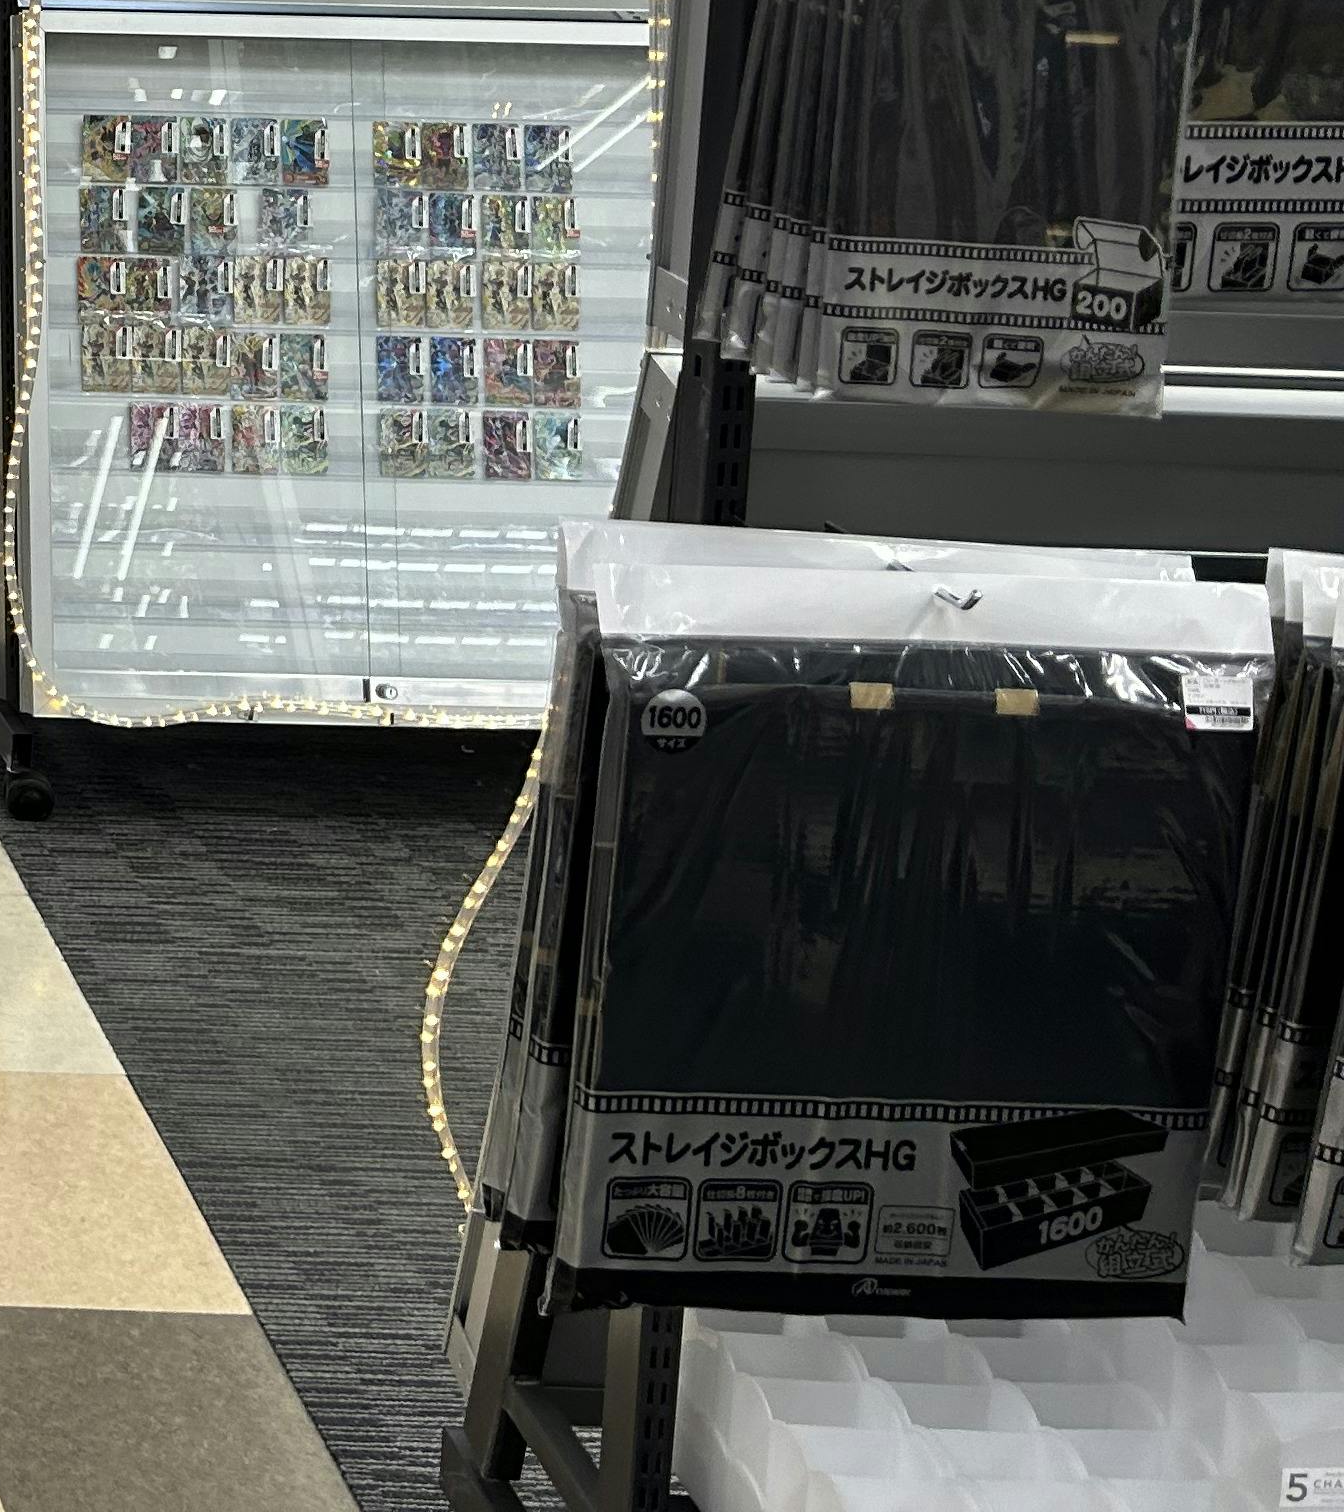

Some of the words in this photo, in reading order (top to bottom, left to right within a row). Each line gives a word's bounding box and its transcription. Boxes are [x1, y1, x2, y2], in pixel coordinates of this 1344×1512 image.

[843, 266, 1068, 303] ストレイジボックスHG
[1075, 290, 1128, 321] 200
[646, 701, 703, 730] 1600
[655, 736, 688, 750] サイズ
[608, 1129, 918, 1172] ストレイジボックスHG
[1038, 1205, 1104, 1246] 1600
[1286, 1472, 1308, 1502] 5
